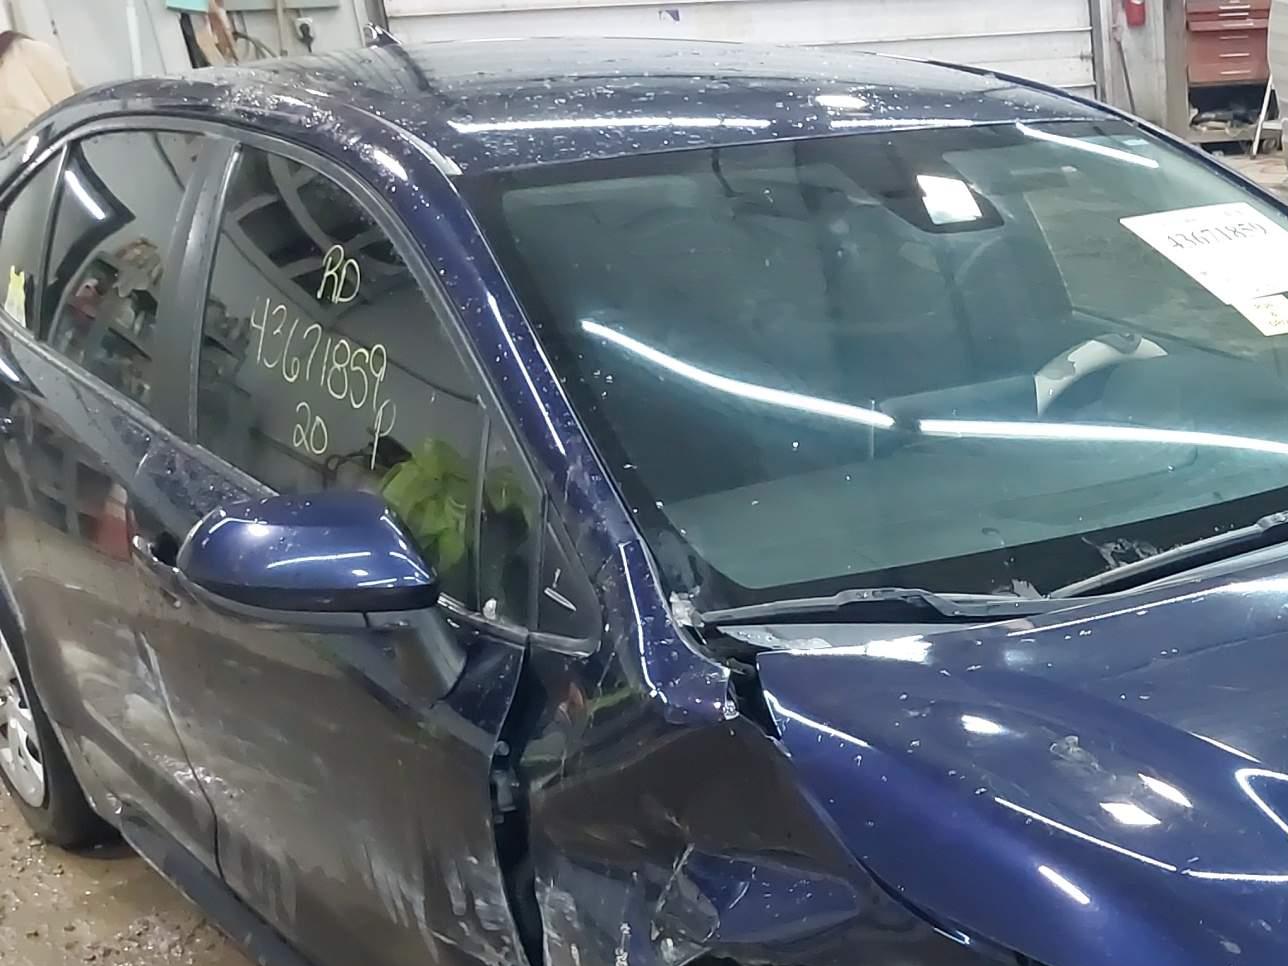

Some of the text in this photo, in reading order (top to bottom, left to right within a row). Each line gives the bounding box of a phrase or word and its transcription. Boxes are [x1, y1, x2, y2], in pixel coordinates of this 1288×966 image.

[317, 244, 361, 304] RD
[250, 296, 387, 412] 43671859
[292, 401, 328, 455] 20
